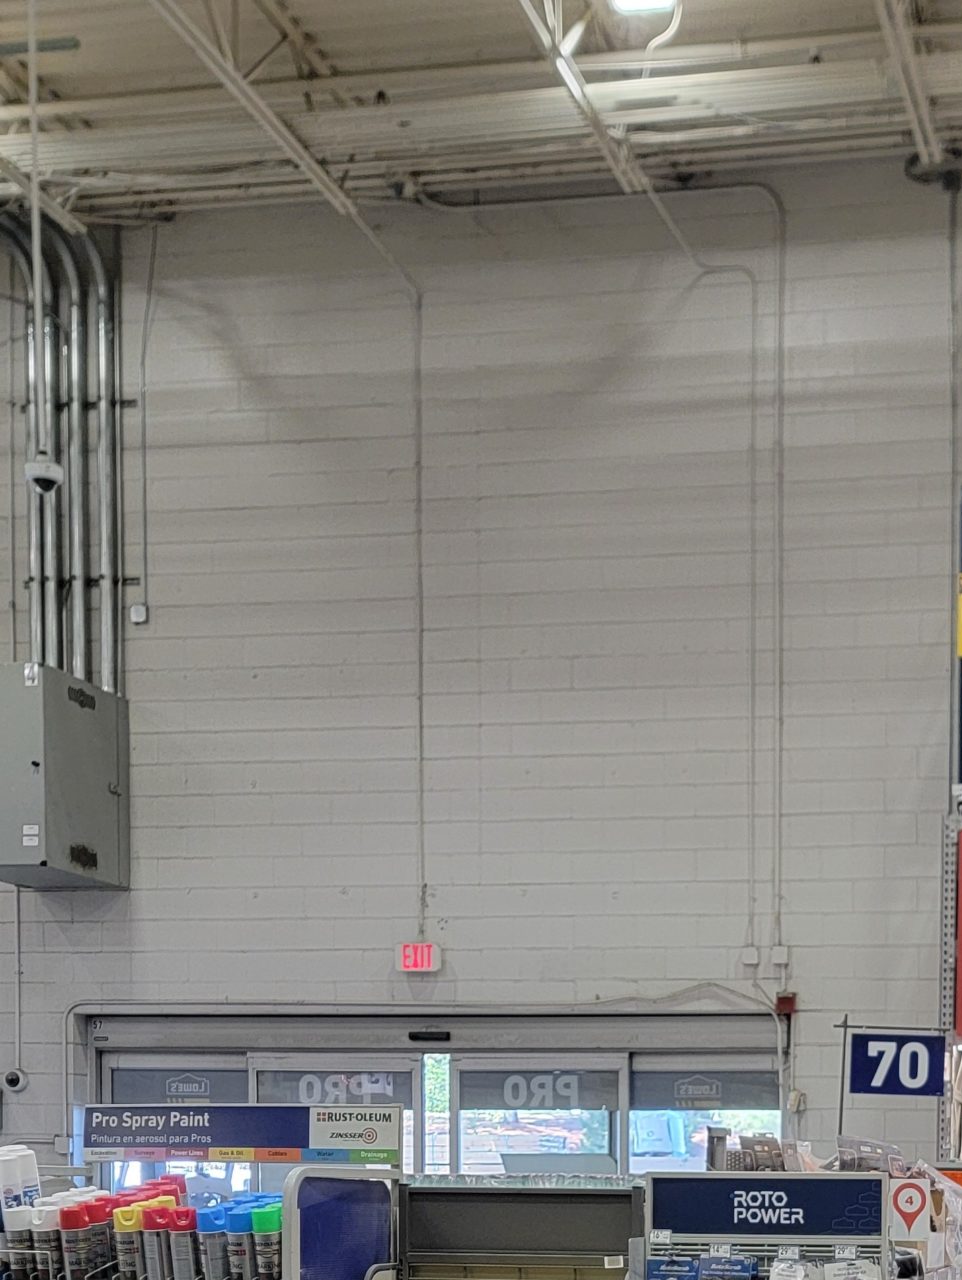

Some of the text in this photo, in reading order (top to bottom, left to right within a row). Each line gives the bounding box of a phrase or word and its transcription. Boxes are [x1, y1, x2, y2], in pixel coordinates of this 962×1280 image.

[402, 943, 433, 969] EXIT
[867, 1041, 929, 1089] 70
[92, 1112, 210, 1130] Pro Spray Paint
[90, 1134, 212, 1146] Pintura en aerosol para Pros
[329, 1131, 364, 1139] ZINSSER
[360, 1151, 388, 1159] Drainage
[734, 1191, 787, 1207] ROTO
[905, 1195, 914, 1206] 4
[734, 1208, 804, 1224] POWER
